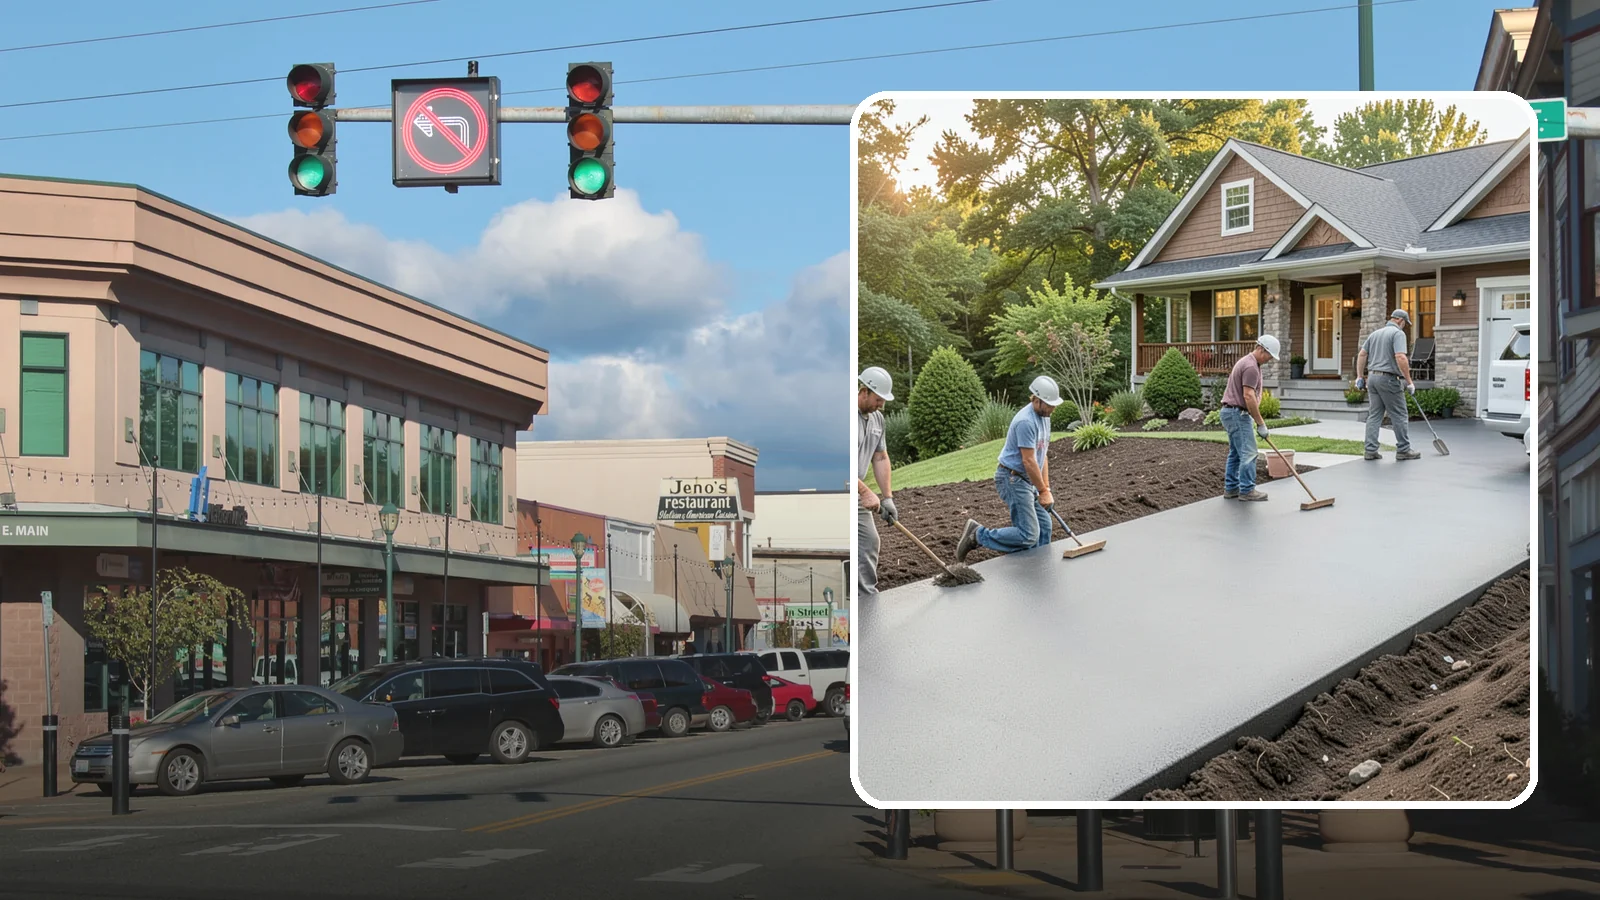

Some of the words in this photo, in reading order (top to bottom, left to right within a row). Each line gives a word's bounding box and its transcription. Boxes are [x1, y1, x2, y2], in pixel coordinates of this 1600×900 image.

[669, 480, 728, 494] Jeno's
[665, 497, 731, 509] restaurant
[686, 510, 714, 519] American
[714, 509, 738, 519] Cuisine
[2, 525, 13, 536] E.
[15, 525, 49, 536] MAIN
[797, 607, 828, 617] Street
